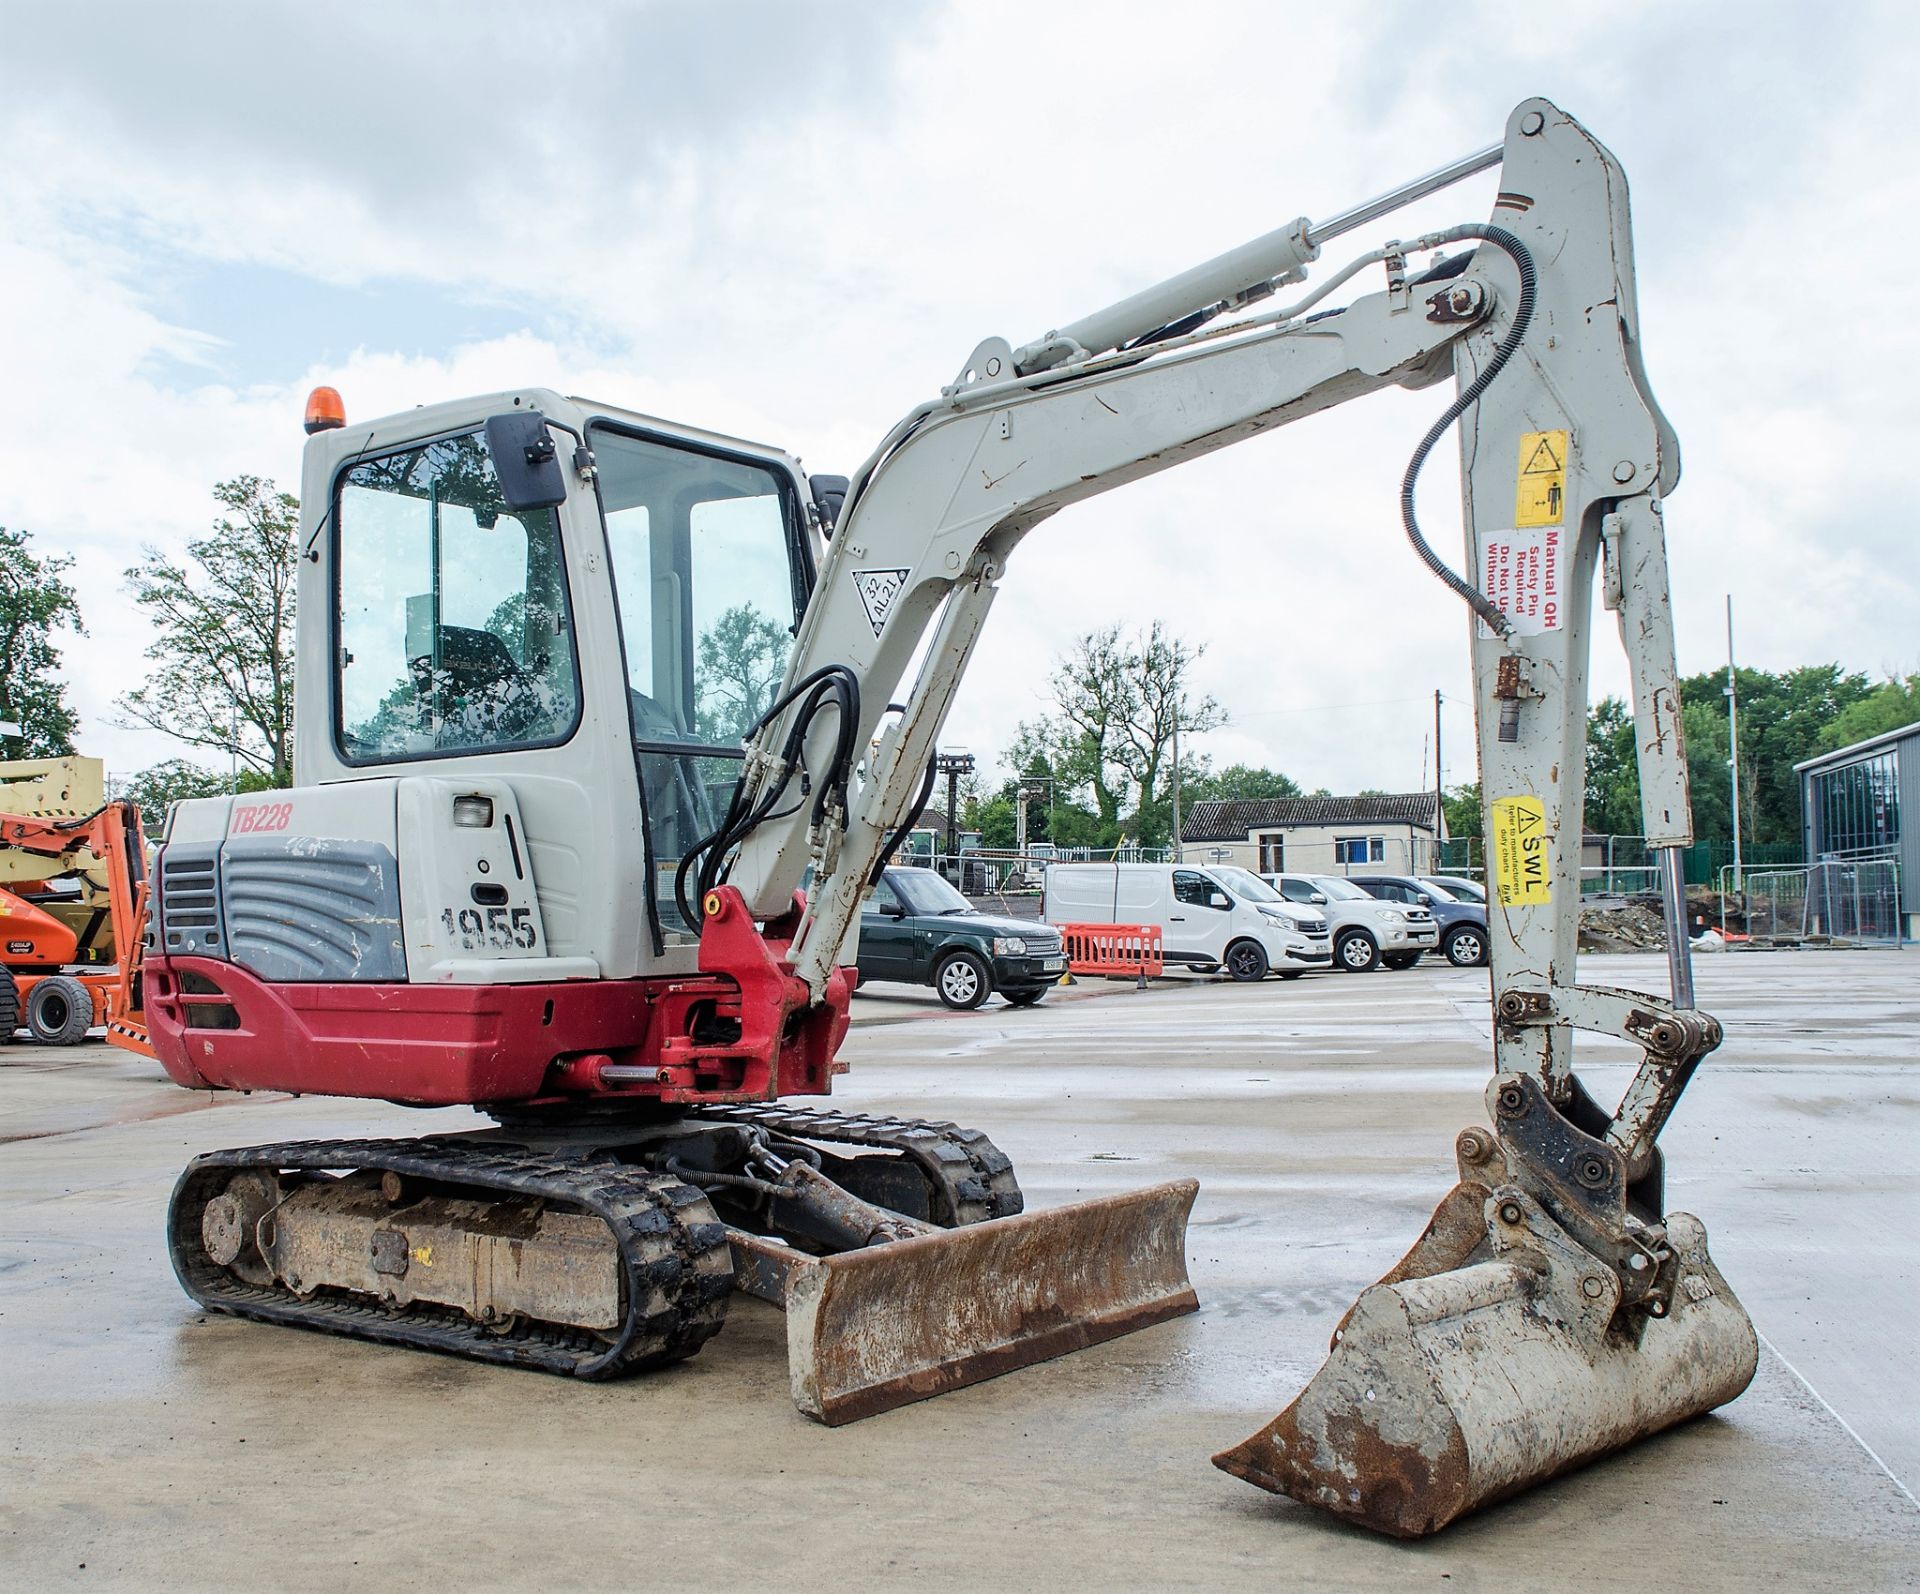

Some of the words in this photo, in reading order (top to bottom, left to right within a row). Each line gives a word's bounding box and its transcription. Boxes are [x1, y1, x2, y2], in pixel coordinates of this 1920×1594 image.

[1500, 546, 1510, 564] Do
[1527, 546, 1539, 590] Safety
[1545, 532, 1558, 596] Manual
[1487, 543, 1498, 596] Without
[1499, 568, 1510, 592] Not
[1515, 551, 1526, 614] Required
[865, 577, 881, 599] 32
[1499, 596, 1509, 614] Us
[1528, 594, 1538, 617] Pin
[1544, 602, 1557, 628] QH
[232, 803, 293, 833] TB228
[1508, 804, 1516, 826] Refer
[1510, 828, 1516, 837] to
[1511, 839, 1519, 896] manufacturers
[1522, 836, 1542, 893] SWL
[441, 908, 537, 949] 1955
